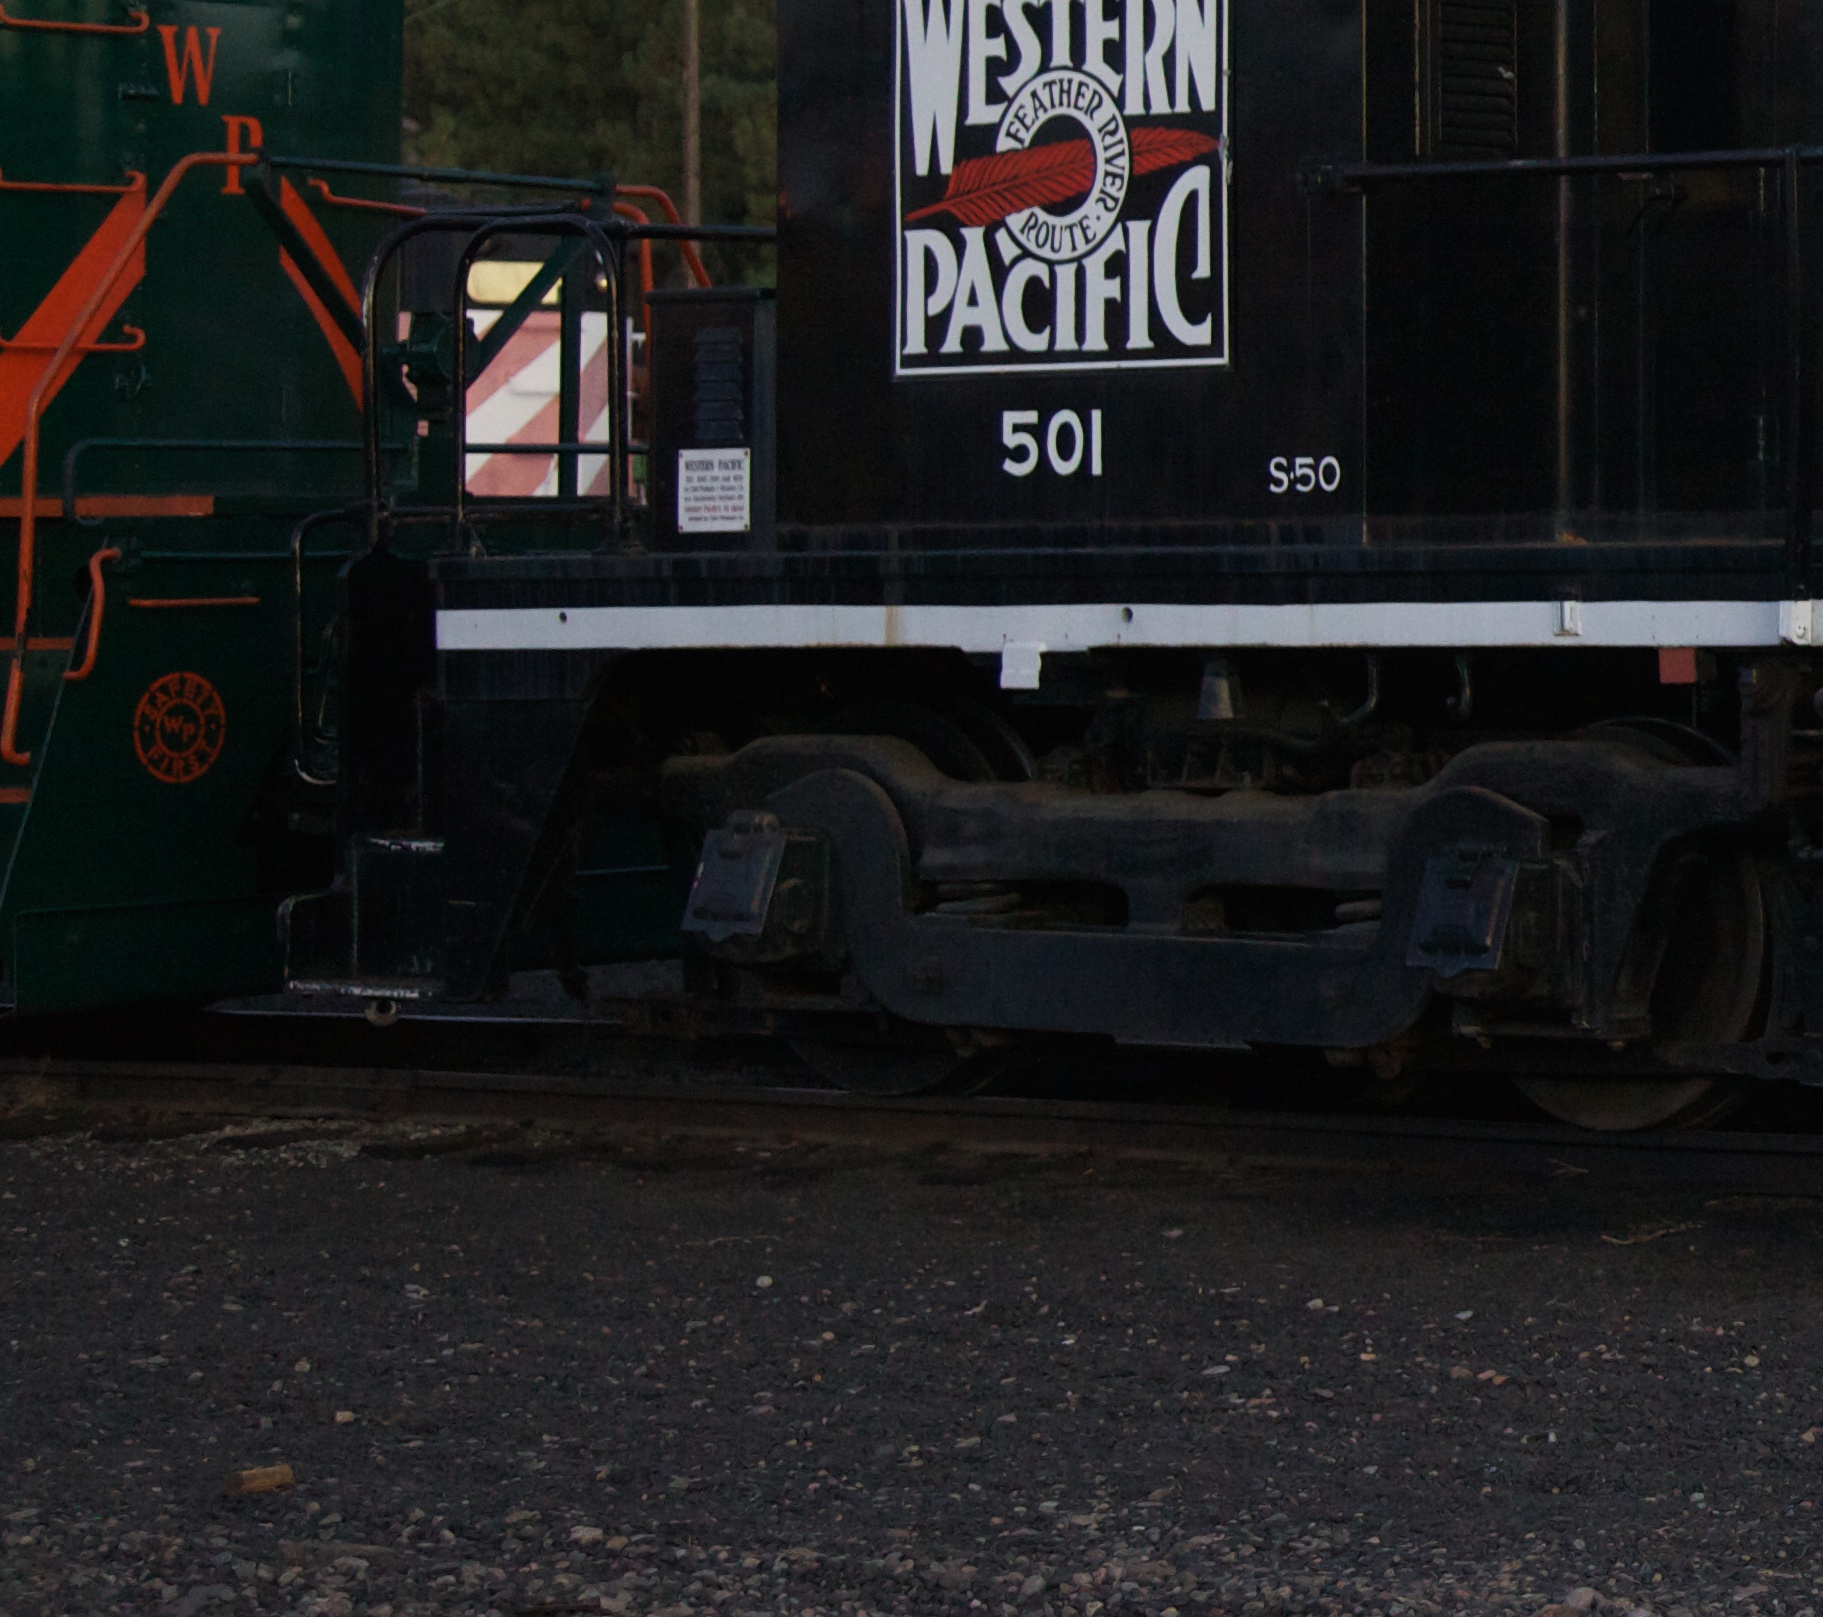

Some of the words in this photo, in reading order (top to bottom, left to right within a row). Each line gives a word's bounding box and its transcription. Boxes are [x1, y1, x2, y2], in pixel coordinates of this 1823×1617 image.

[1005, 77, 1104, 146] FEATHER
[1096, 113, 1126, 212] RIVER
[902, 165, 1213, 356] PACIFIC
[1020, 211, 1097, 254] ROUTE
[1002, 408, 1103, 478] 501
[143, 676, 219, 719] SAFETY
